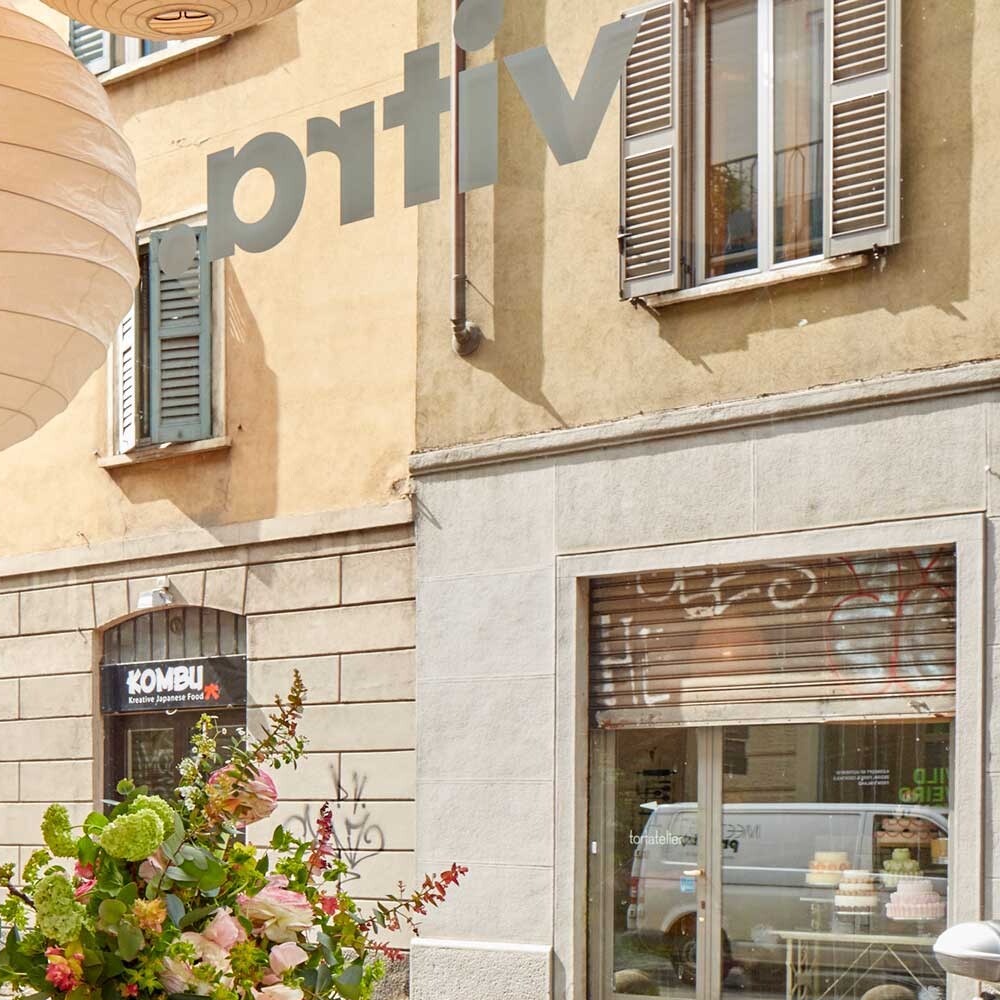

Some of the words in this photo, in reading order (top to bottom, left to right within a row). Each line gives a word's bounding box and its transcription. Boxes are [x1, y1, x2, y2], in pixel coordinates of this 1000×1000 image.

[126, 665, 204, 695] KOMBU
[128, 695, 155, 704] Kreative
[156, 693, 186, 704] Japanese
[187, 692, 204, 701] Food
